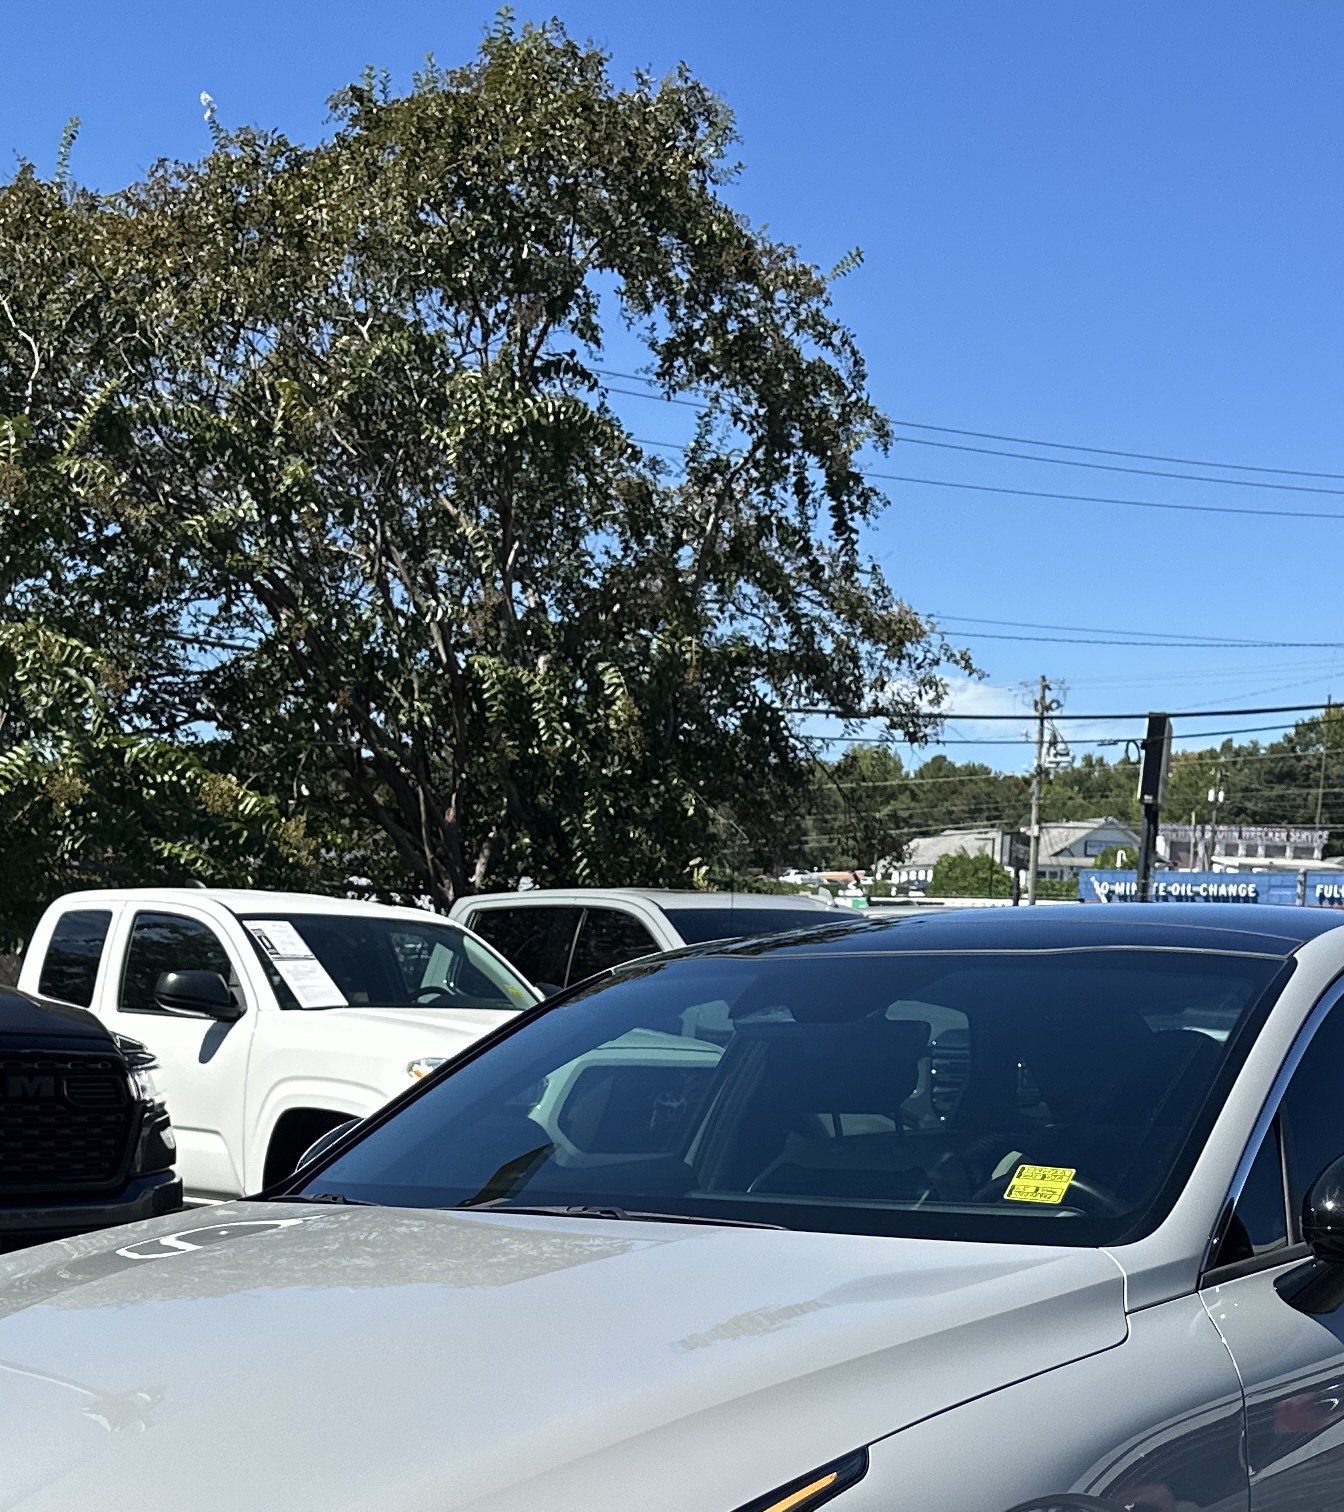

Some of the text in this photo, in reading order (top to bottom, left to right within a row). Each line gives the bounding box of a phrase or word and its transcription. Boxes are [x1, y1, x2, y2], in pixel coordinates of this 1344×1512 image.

[1115, 881, 1167, 896] MINTE
[1171, 882, 1194, 896] OIL
[1199, 883, 1256, 898] CHANGE
